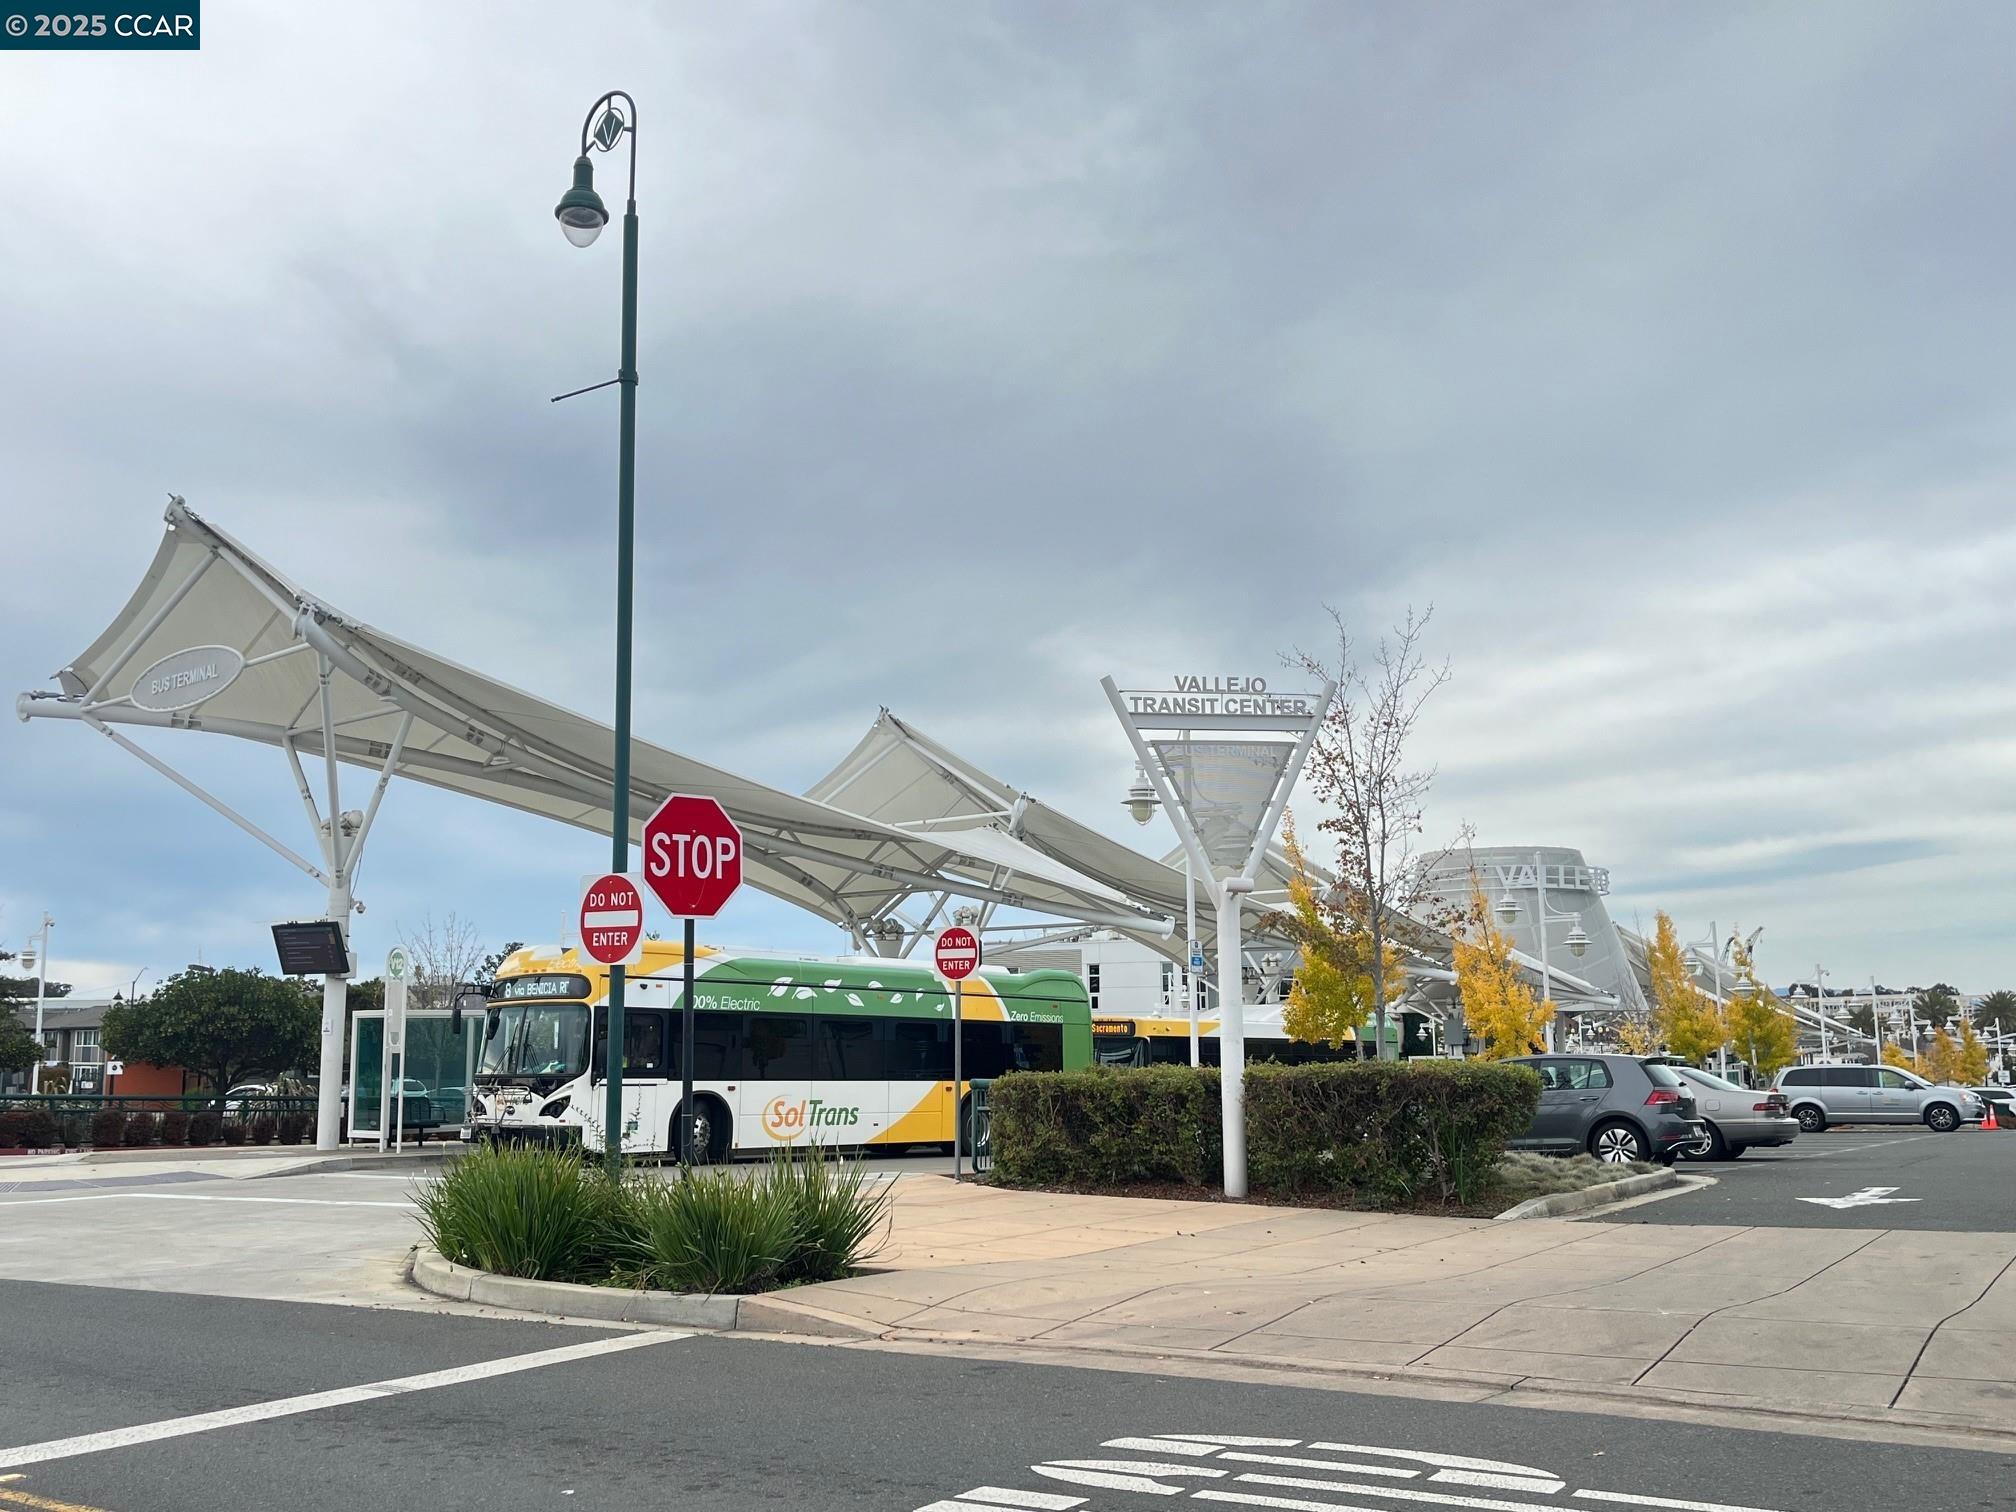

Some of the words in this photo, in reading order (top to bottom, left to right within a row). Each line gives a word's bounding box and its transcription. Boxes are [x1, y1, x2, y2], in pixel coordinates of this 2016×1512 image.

[151, 676, 170, 695] BUS
[171, 663, 218, 689] TERMINAL
[1174, 675, 1267, 693] VALLEJO
[1129, 696, 1219, 715] TRANSIT
[1224, 698, 1307, 716] CENTER
[650, 831, 736, 879] STOP
[590, 893, 605, 907] DO
[610, 891, 633, 906] NOT
[592, 931, 628, 947] ENTER
[941, 937, 953, 947] DO
[955, 936, 972, 947] NOT
[942, 960, 970, 970] ENTER
[505, 983, 512, 998] 8
[514, 983, 524, 995] via
[526, 981, 557, 995] BENICIA
[693, 995, 718, 1009] 00%
[720, 995, 760, 1011] Electric
[1010, 1010, 1028, 1021] Zero
[1030, 1011, 1064, 1023] Emissions
[1091, 1023, 1128, 1033] Sacramento
